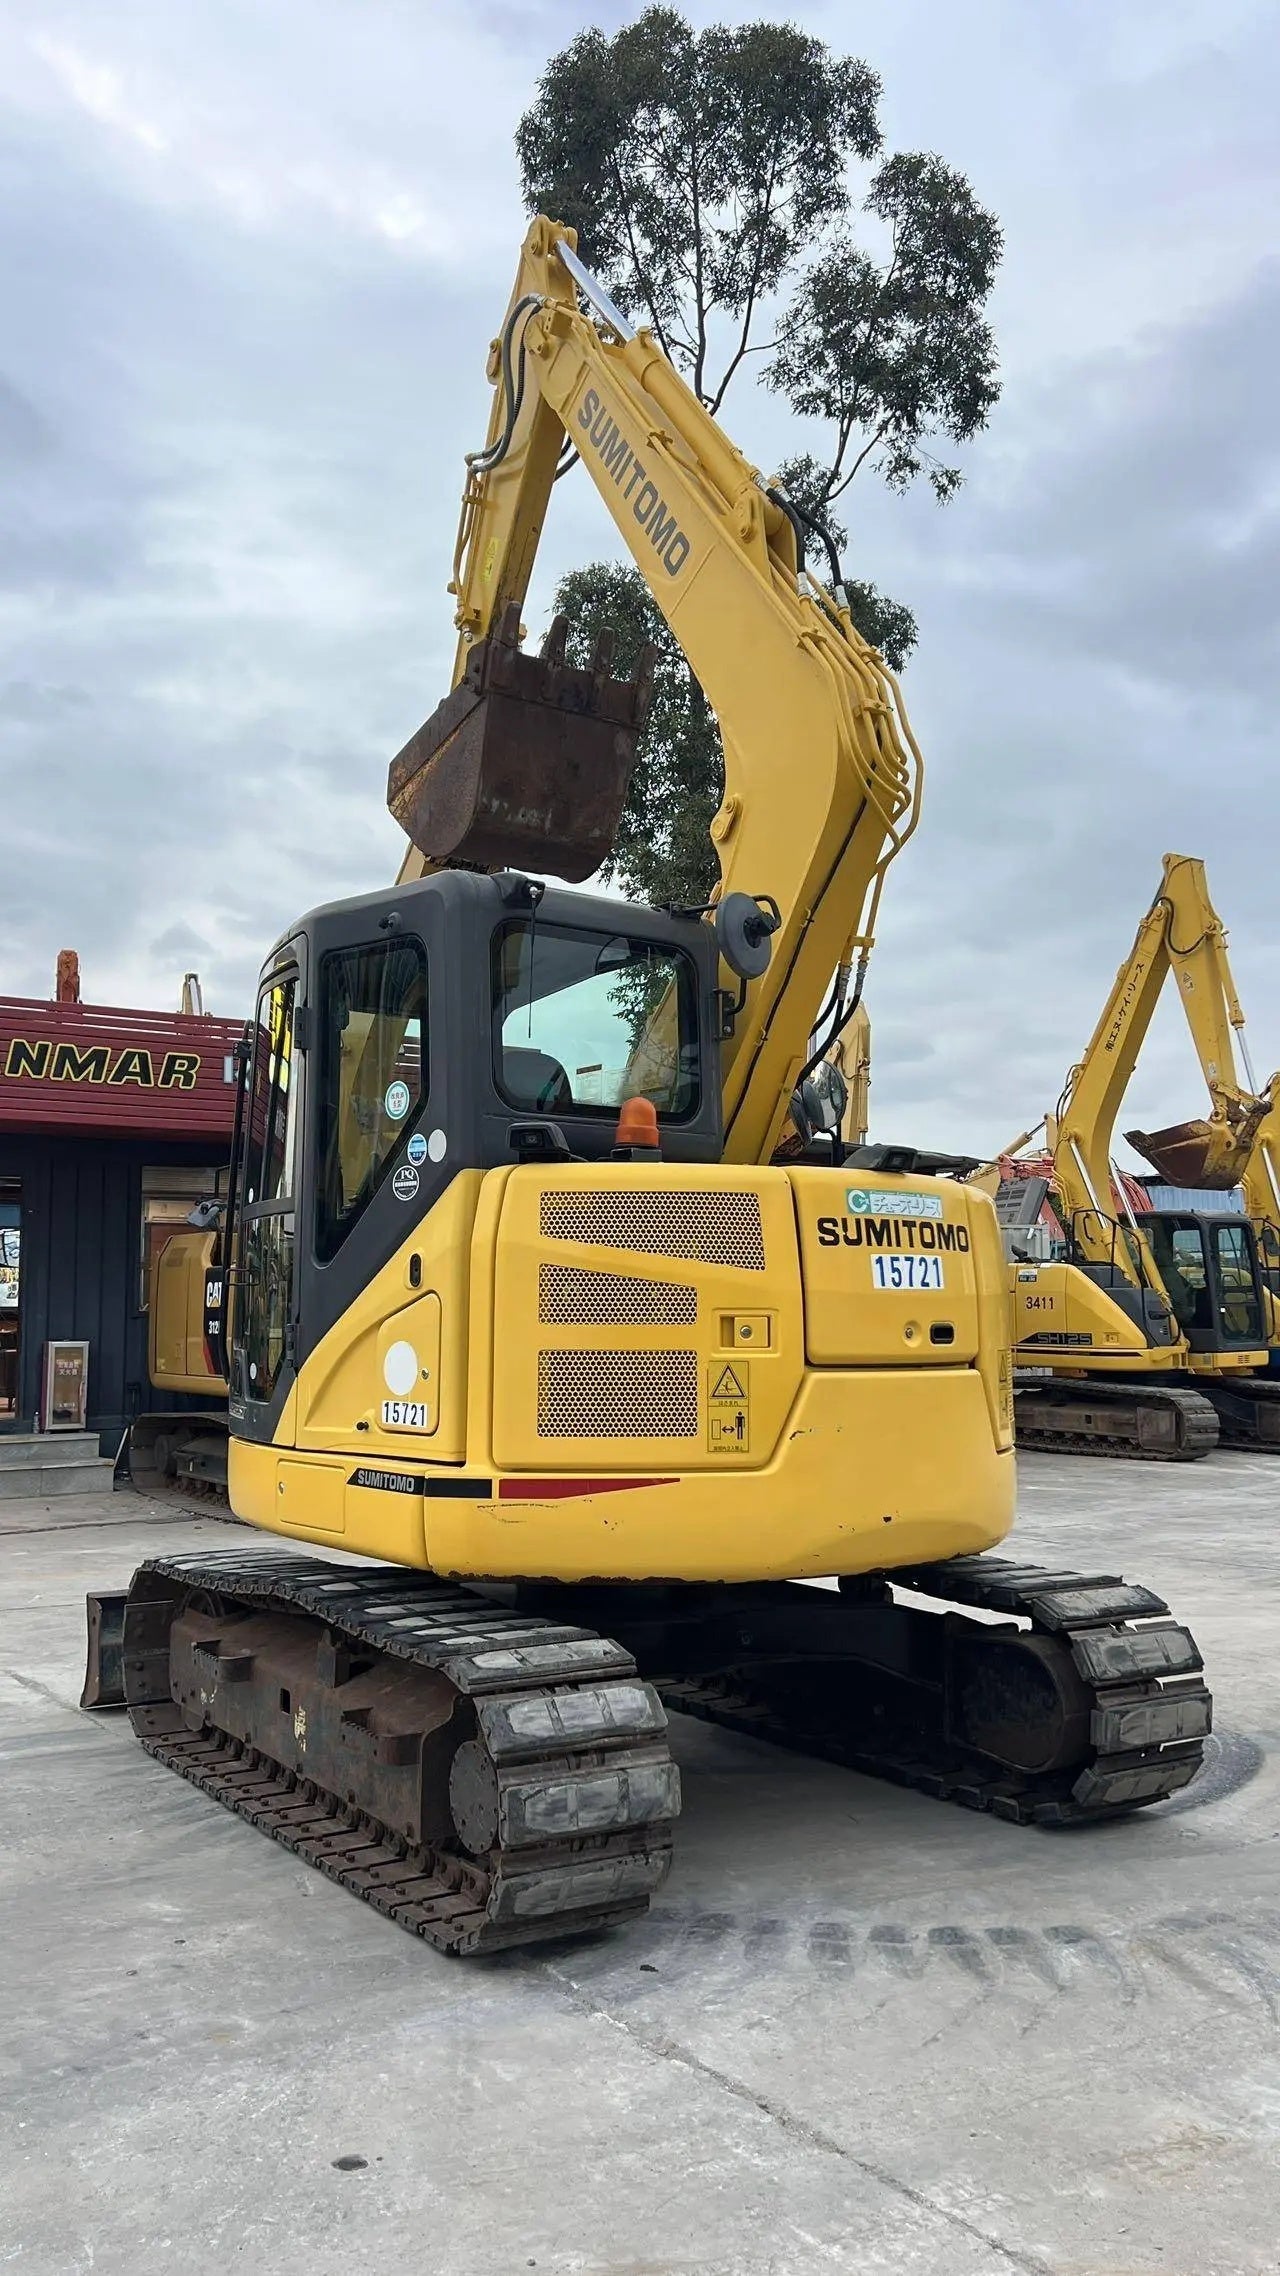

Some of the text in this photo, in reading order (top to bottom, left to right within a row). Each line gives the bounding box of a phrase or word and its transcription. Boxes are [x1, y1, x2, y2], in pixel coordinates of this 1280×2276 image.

[577, 388, 691, 577] SUMITOMO
[4, 1038, 201, 1090] NMAR
[817, 1217, 969, 1252] SUMITOMO
[875, 1256, 941, 1287] 15721
[1026, 1296, 1054, 1310] 3411
[208, 1320, 220, 1334] 312
[1037, 1333, 1091, 1345] SH125
[384, 1402, 425, 1426] 15721
[357, 1470, 415, 1492] SUMITOMO
